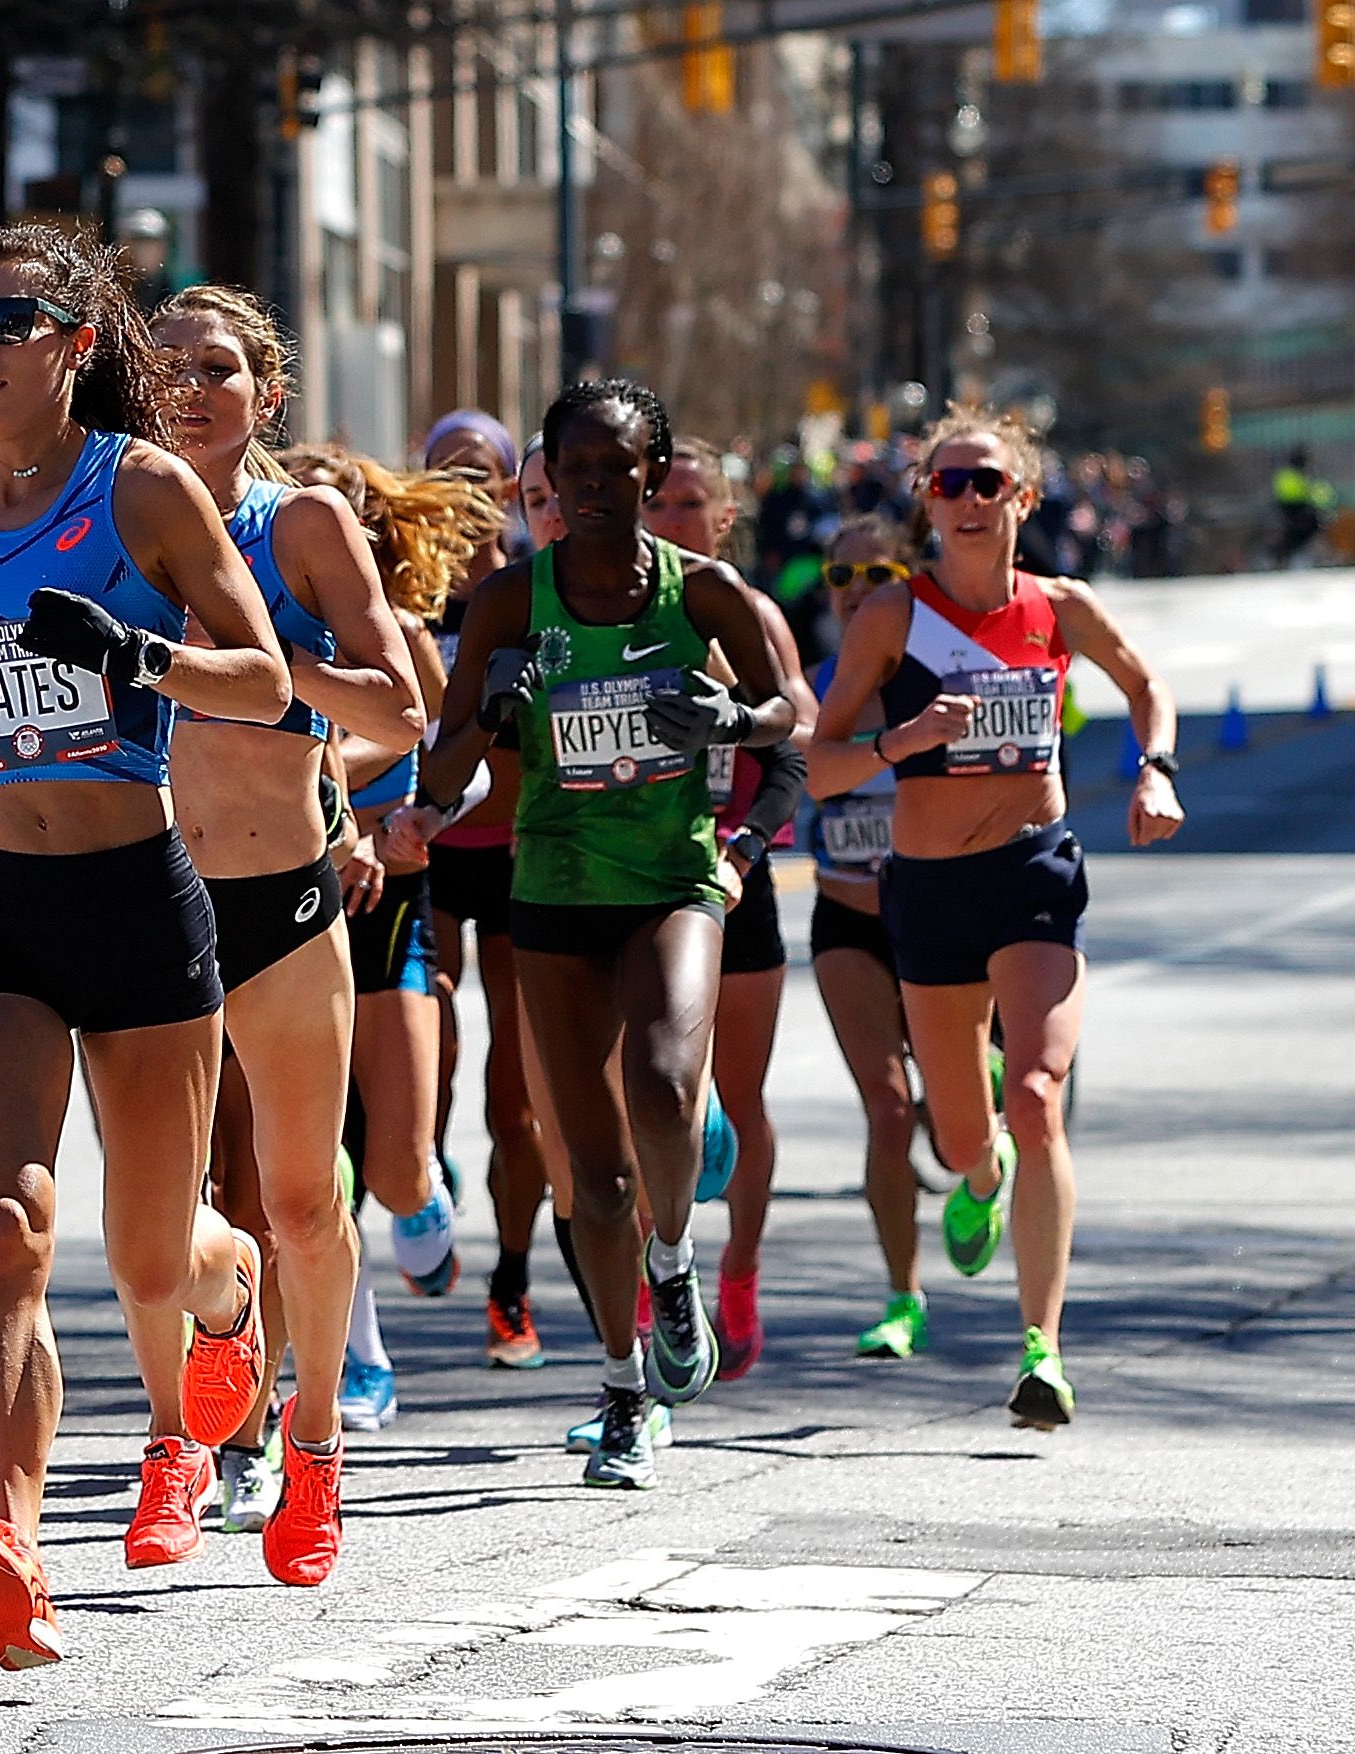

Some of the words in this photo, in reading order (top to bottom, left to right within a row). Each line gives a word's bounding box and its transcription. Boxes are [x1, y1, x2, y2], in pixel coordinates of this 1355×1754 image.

[604, 676, 651, 694] OLYMPIC
[962, 698, 1052, 739] RONER
[828, 818, 891, 851] LAND
